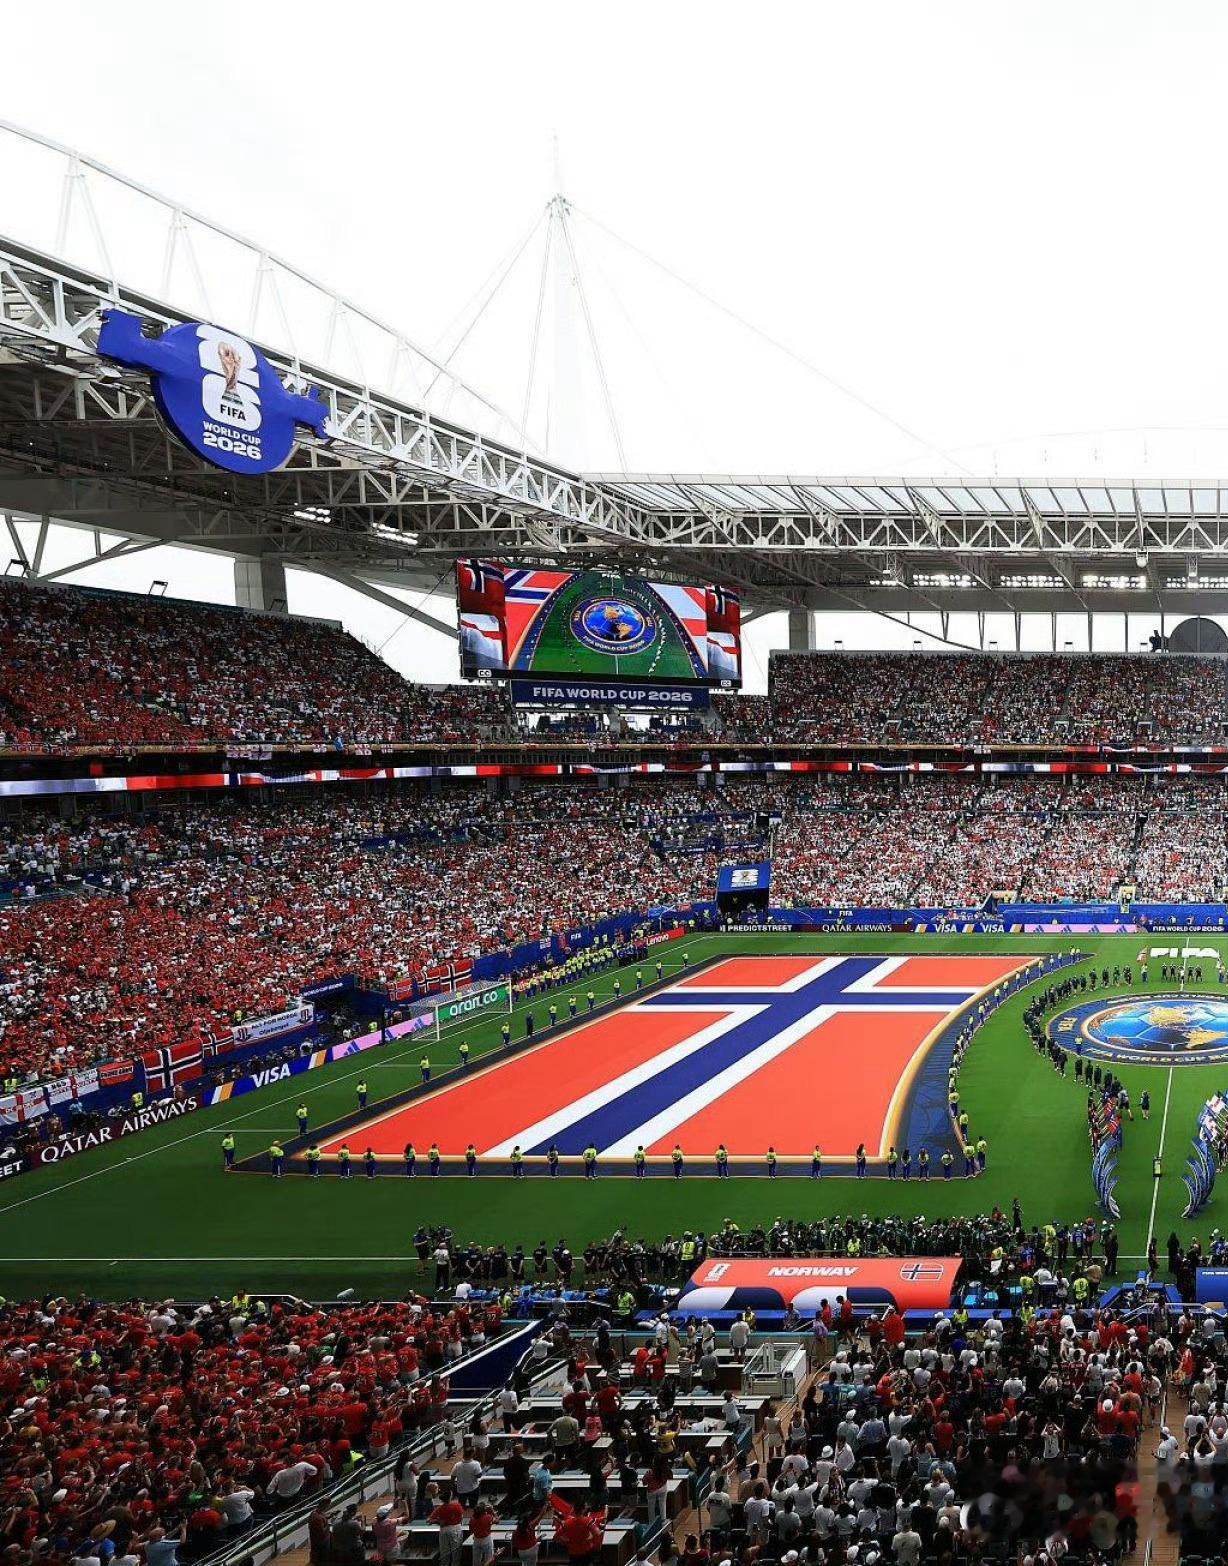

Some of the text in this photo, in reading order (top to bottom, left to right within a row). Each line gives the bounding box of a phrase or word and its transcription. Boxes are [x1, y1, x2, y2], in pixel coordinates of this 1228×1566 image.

[220, 404, 246, 421] FIFA
[203, 420, 261, 446] WORLD CUP
[203, 431, 262, 460] 2026
[533, 687, 693, 702] FIFA WORLD CUP 2026
[822, 924, 893, 933] QATAR AIRWAYS
[933, 923, 957, 933] VISA
[980, 922, 1005, 933] VISA
[646, 933, 669, 946] Lenovo
[1150, 947, 1220, 958] FIFA
[250, 1062, 291, 1088] VISA
[40, 1096, 198, 1164] QATAR AIRWAYS
[768, 1266, 860, 1277] NORWAY
